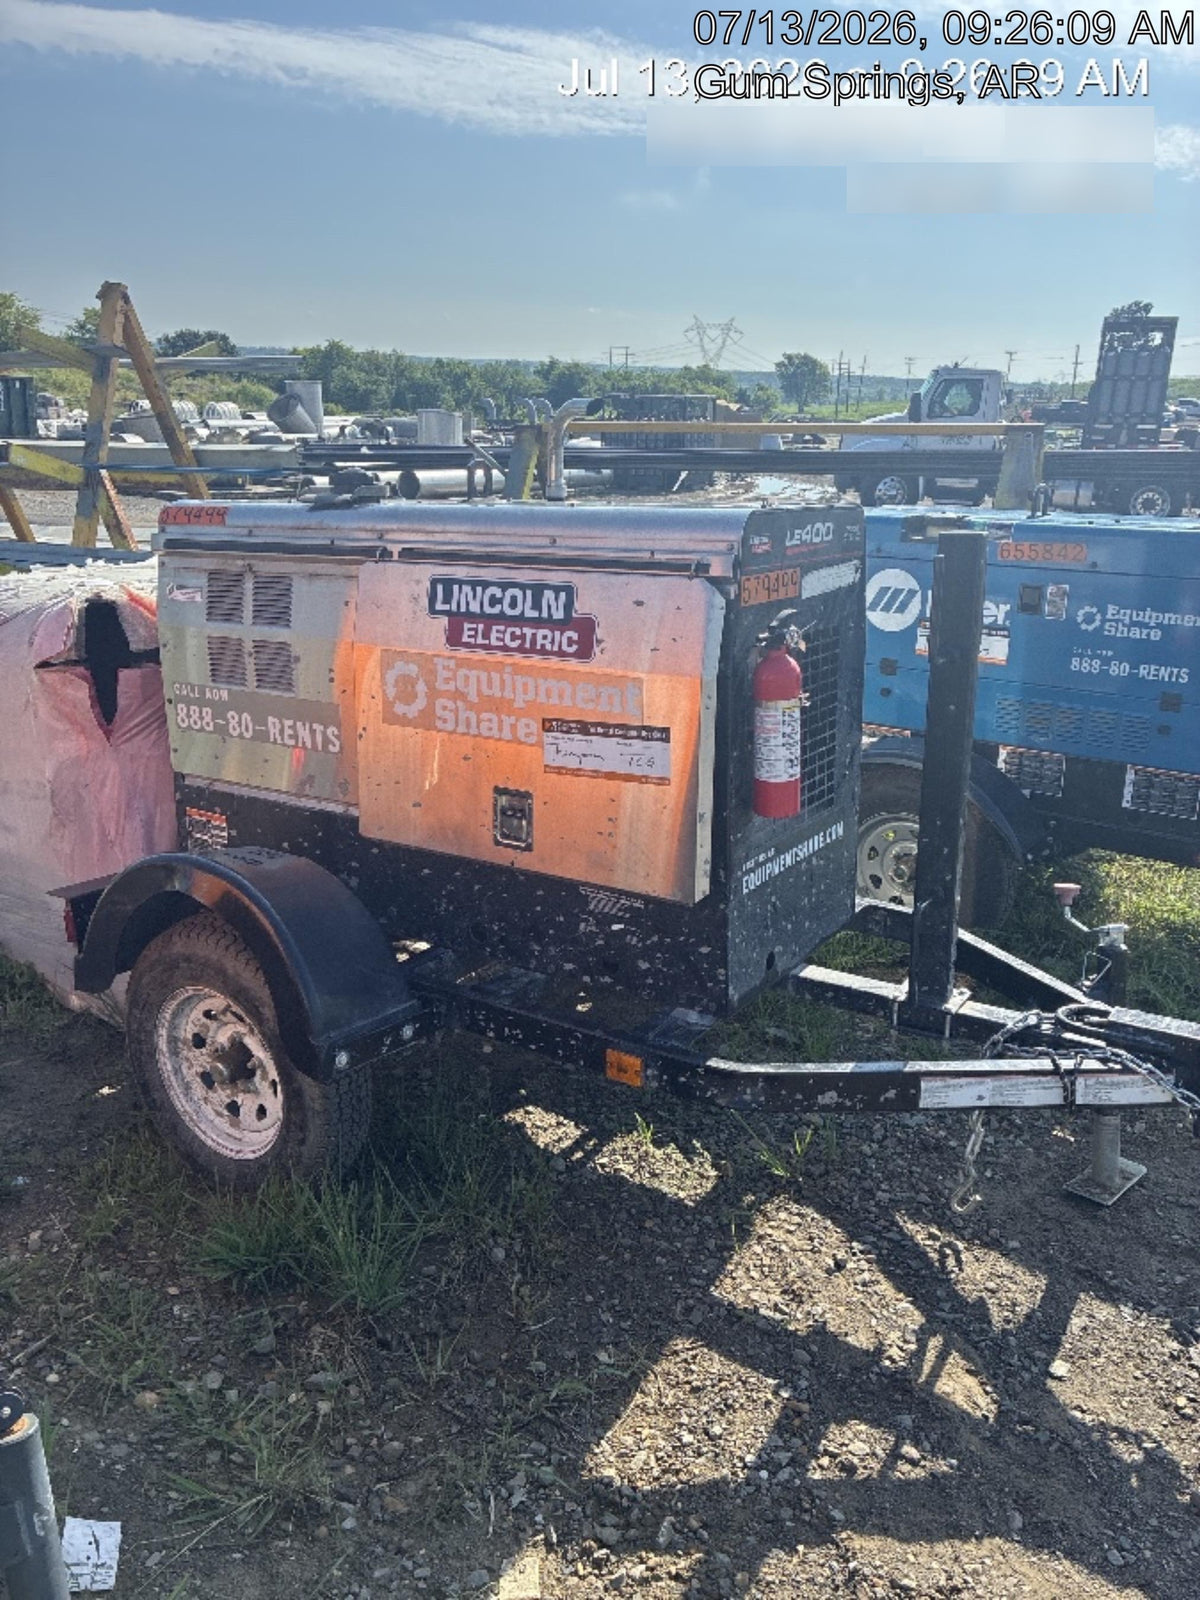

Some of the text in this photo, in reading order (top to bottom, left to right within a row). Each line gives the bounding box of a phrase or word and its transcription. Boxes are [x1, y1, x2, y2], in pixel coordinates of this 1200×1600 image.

[1000, 542, 1084, 562] 655842
[434, 582, 567, 620] LINCOLN
[461, 622, 579, 653] ELECTRIC
[1103, 621, 1163, 641] Share
[1070, 656, 1191, 684] 888-80-RENTS
[173, 682, 200, 698] CALL
[432, 656, 643, 717] Equipment
[176, 703, 341, 754] 888-80-RENTS
[433, 697, 539, 745] Share
